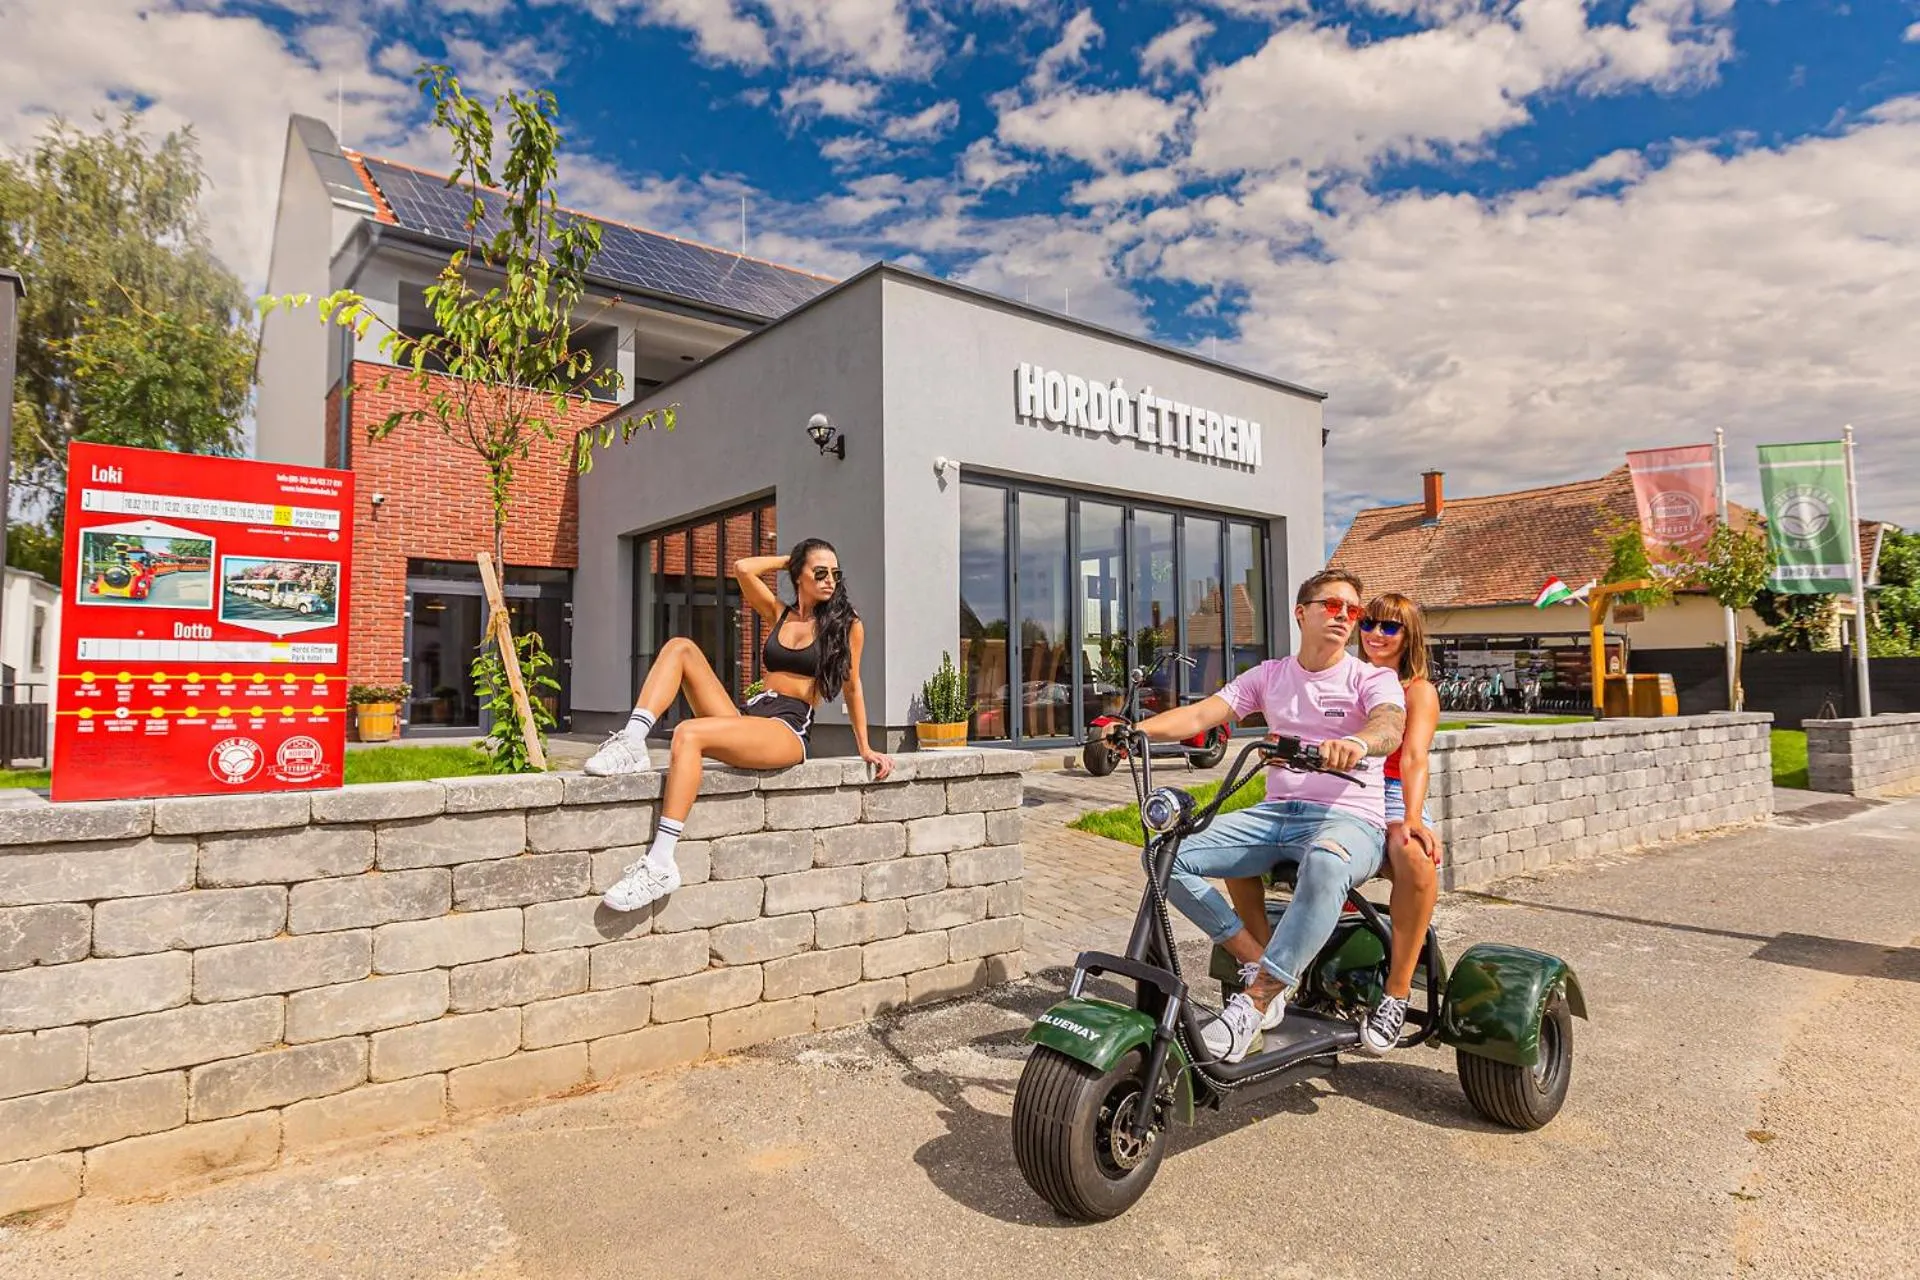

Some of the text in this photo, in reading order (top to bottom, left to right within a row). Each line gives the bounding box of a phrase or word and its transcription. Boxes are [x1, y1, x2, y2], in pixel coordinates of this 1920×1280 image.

[1019, 362, 1262, 467] HORDÓ ÉTTEREM
[91, 464, 124, 484] Loki
[173, 622, 213, 639] Dotto
[1038, 1014, 1101, 1041] BLUEWAY
